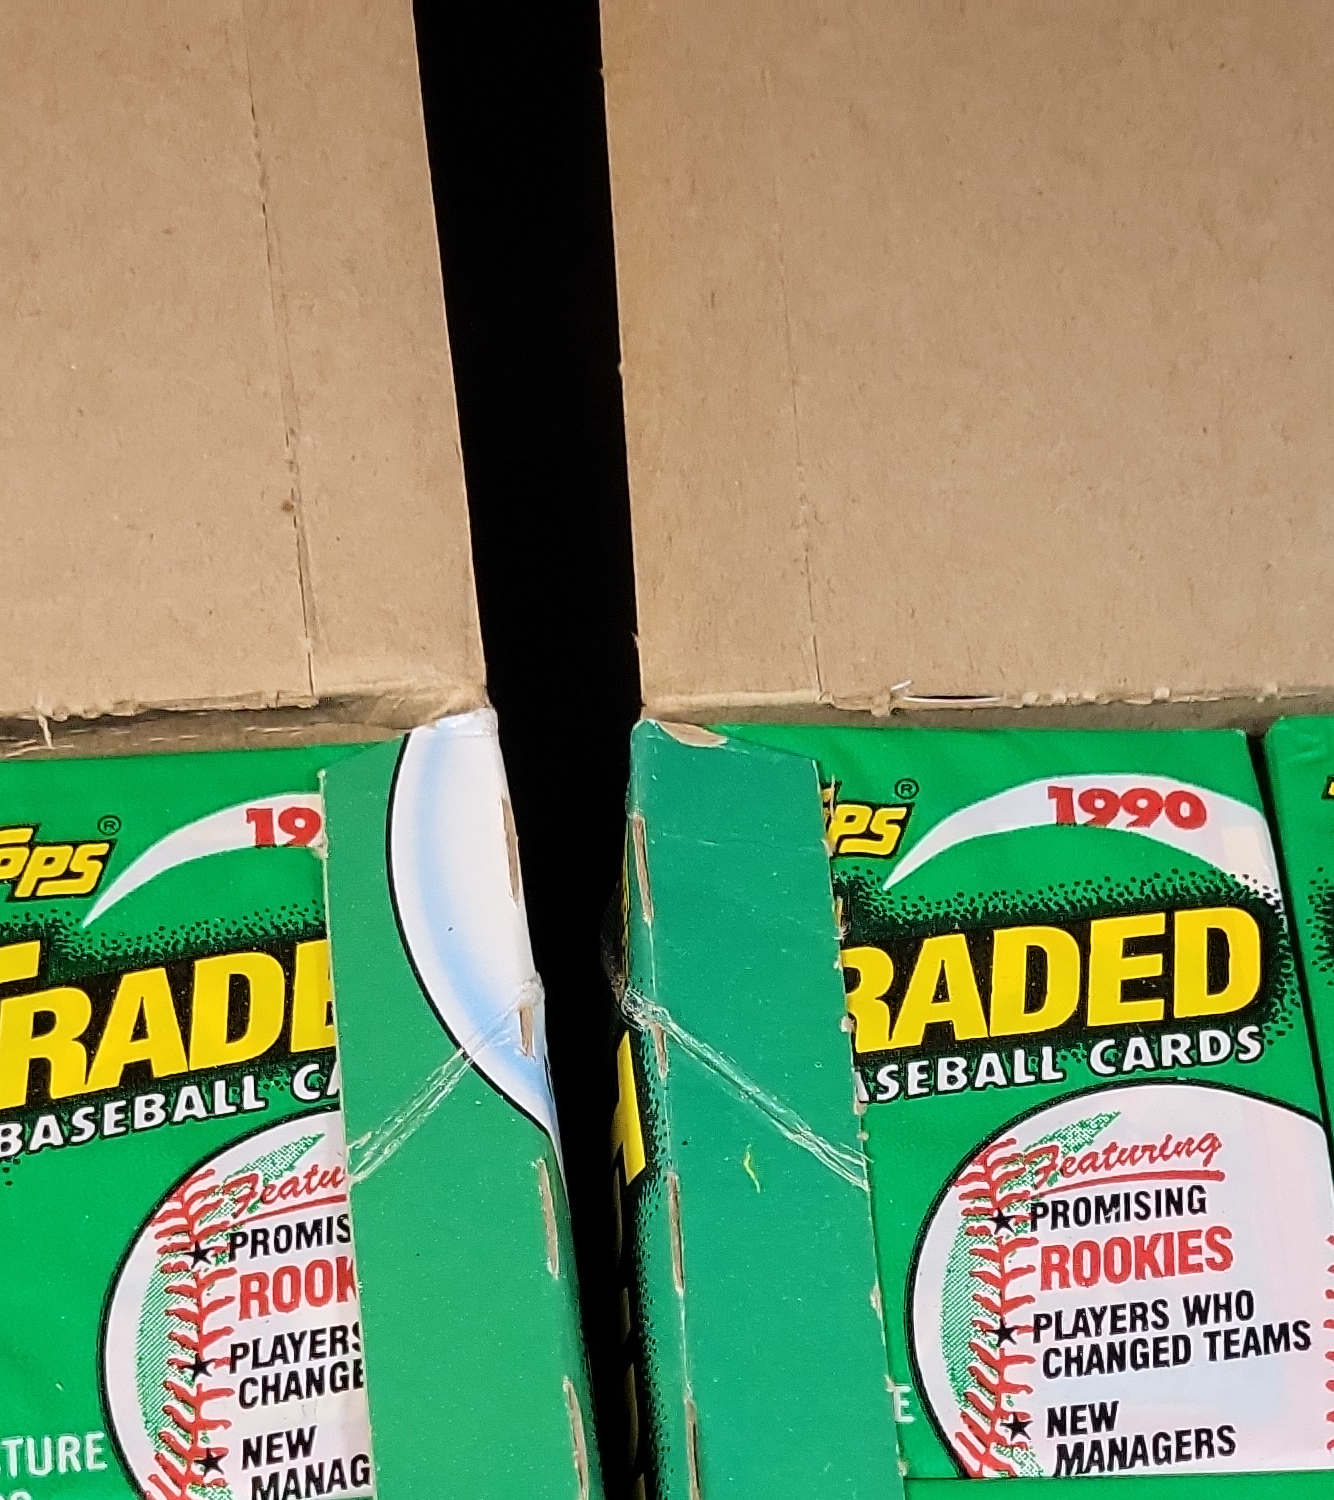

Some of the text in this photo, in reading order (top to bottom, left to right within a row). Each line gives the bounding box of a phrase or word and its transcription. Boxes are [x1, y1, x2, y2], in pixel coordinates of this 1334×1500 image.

[1047, 786, 1207, 830] 1990
[840, 899, 1262, 1054] RADED
[1090, 1027, 1263, 1076] CARDS
[1026, 1133, 1223, 1191] Featuring
[1030, 1185, 1207, 1232] PROMISING
[229, 1214, 351, 1262] PROMIS
[1040, 1225, 1233, 1291] ROOKIES
[1033, 1289, 1255, 1344] PLAYERS WHO
[1043, 1320, 1311, 1380] CHANGED TEAMS
[1046, 1401, 1119, 1438] NEW
[241, 1425, 317, 1471] NEW
[1054, 1426, 1236, 1476] MANAGERS
